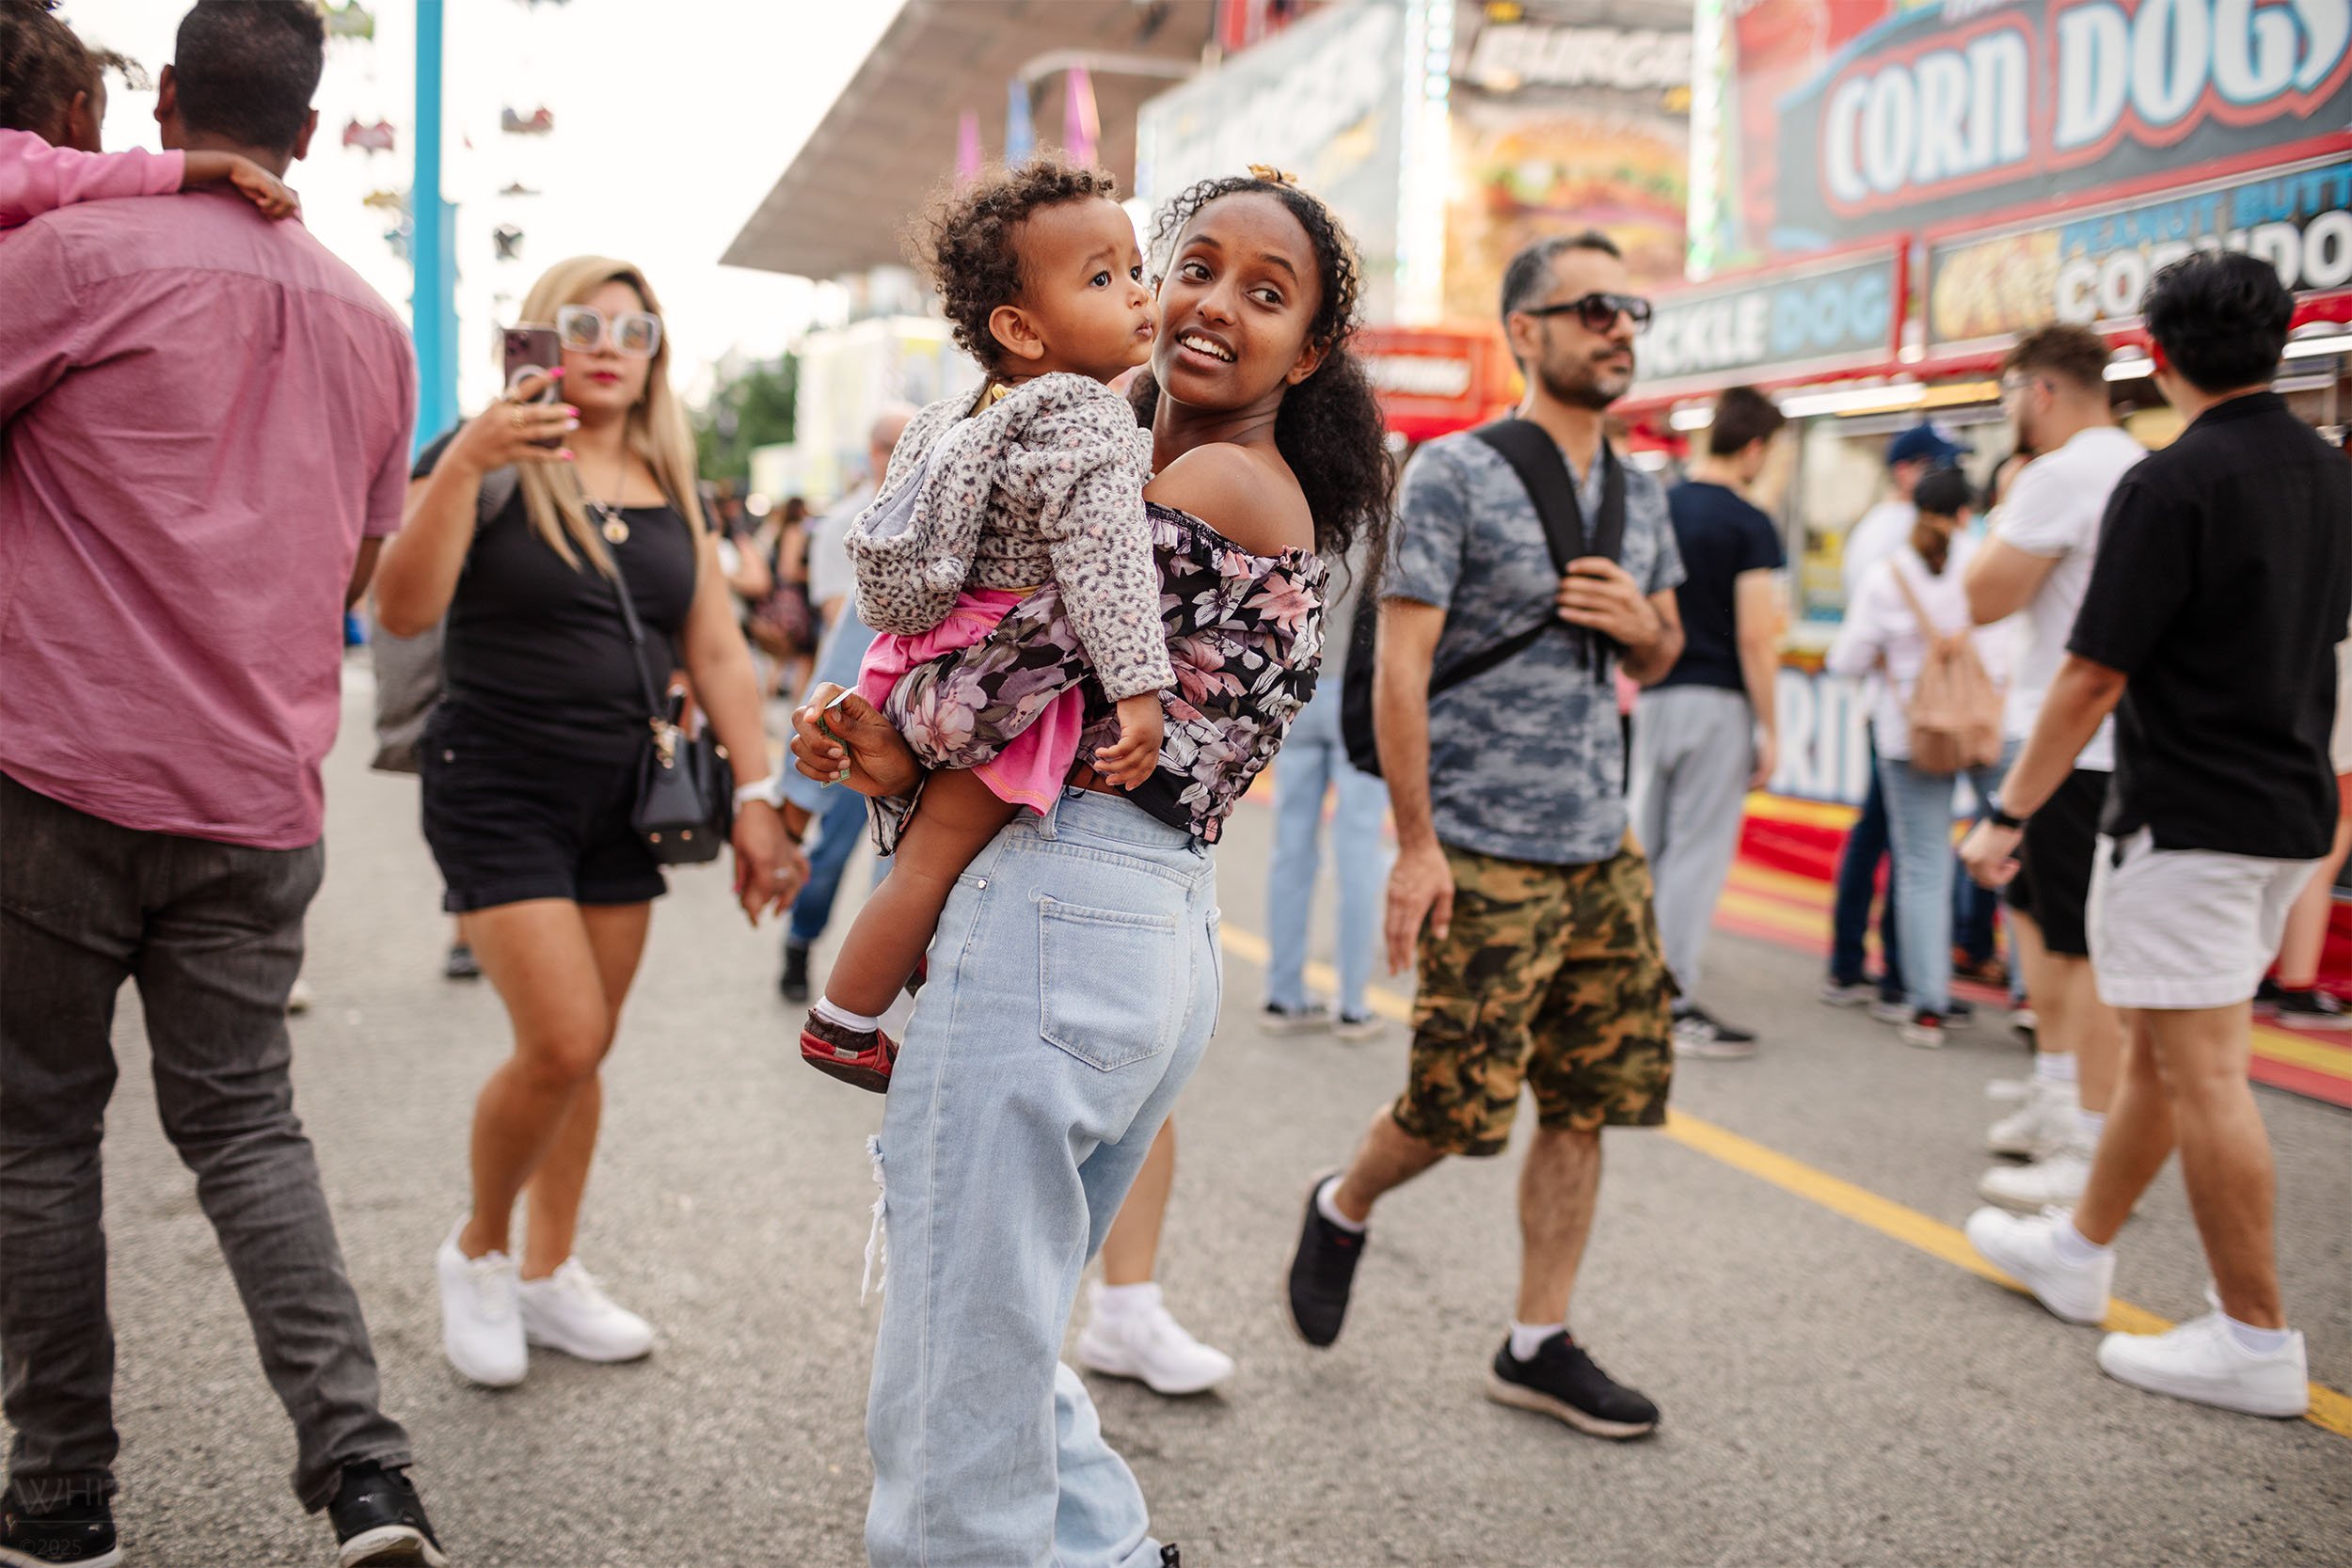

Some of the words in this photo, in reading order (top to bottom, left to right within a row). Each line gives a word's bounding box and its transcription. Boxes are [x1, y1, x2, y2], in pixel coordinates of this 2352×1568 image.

[1823, 30, 2031, 201] CORN
[2054, 0, 2352, 150] DOGS
[2060, 191, 2226, 260] PEANUT
[1638, 293, 1769, 379] ICKLE
[1772, 271, 1891, 353] DOG
